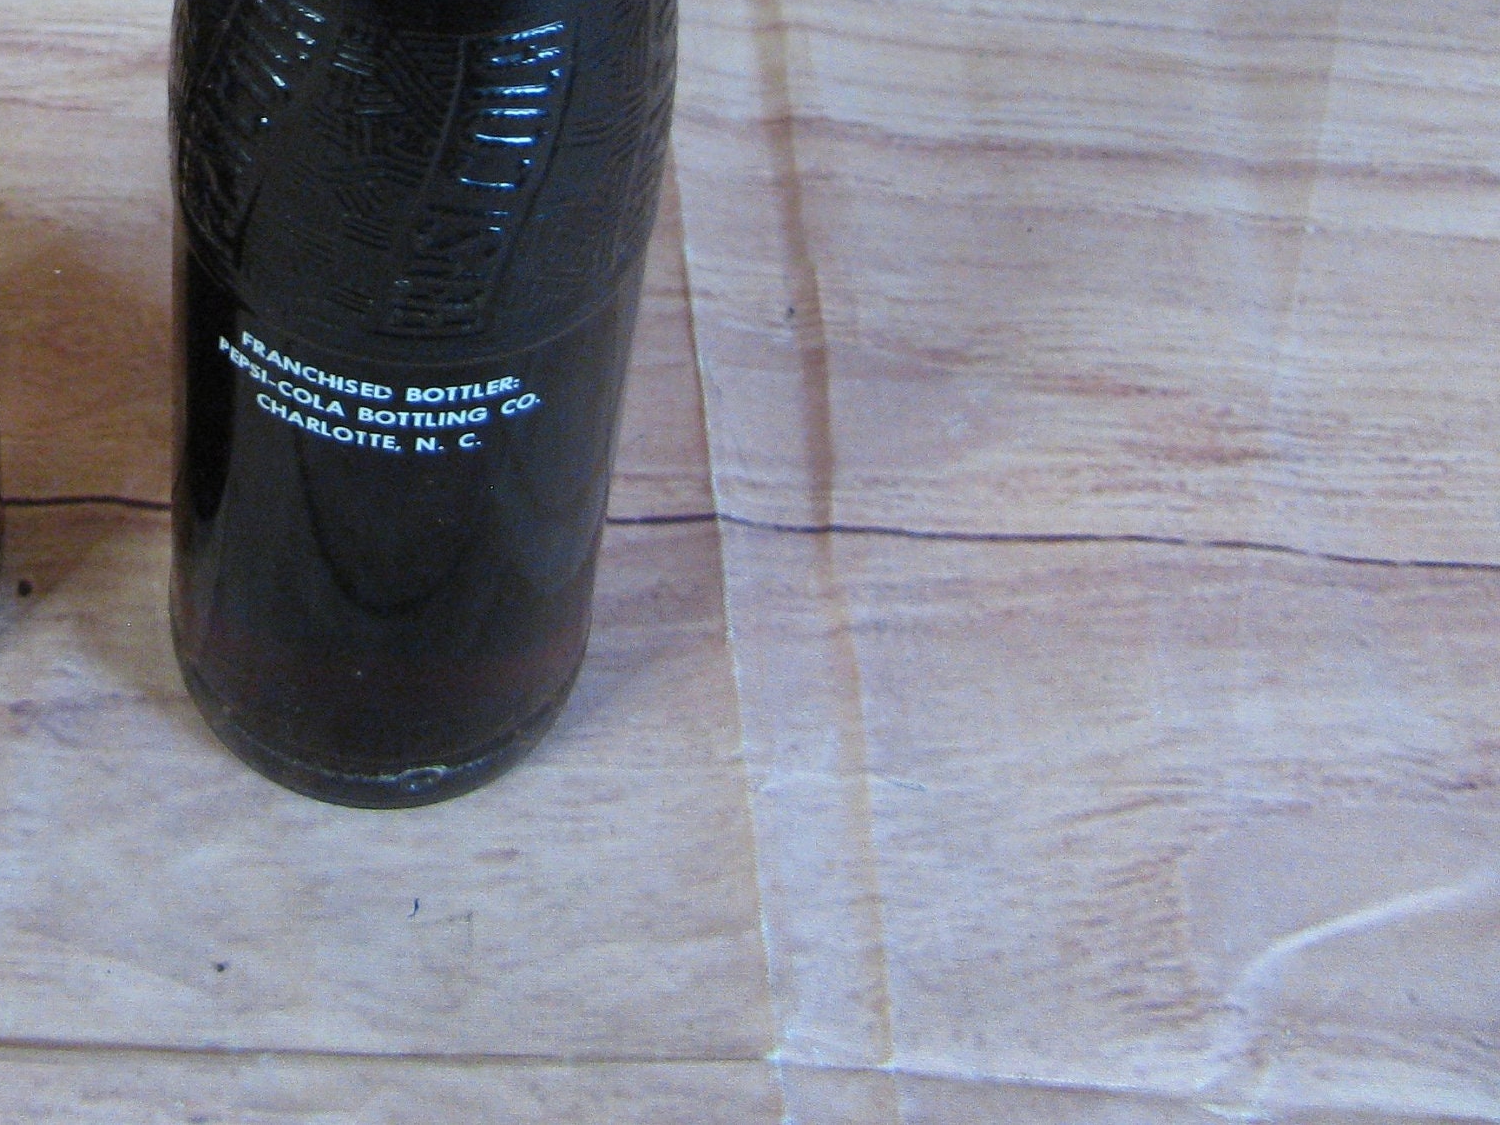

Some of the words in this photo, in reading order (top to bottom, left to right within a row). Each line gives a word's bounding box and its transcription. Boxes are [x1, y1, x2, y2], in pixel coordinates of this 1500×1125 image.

[218, 335, 346, 418] PEPSI-COLA
[357, 406, 488, 428] BOTTLING
[500, 391, 542, 418] CO.
[241, 330, 394, 400] FRANCHISED
[415, 436, 445, 452] N.
[458, 432, 482, 449] C.
